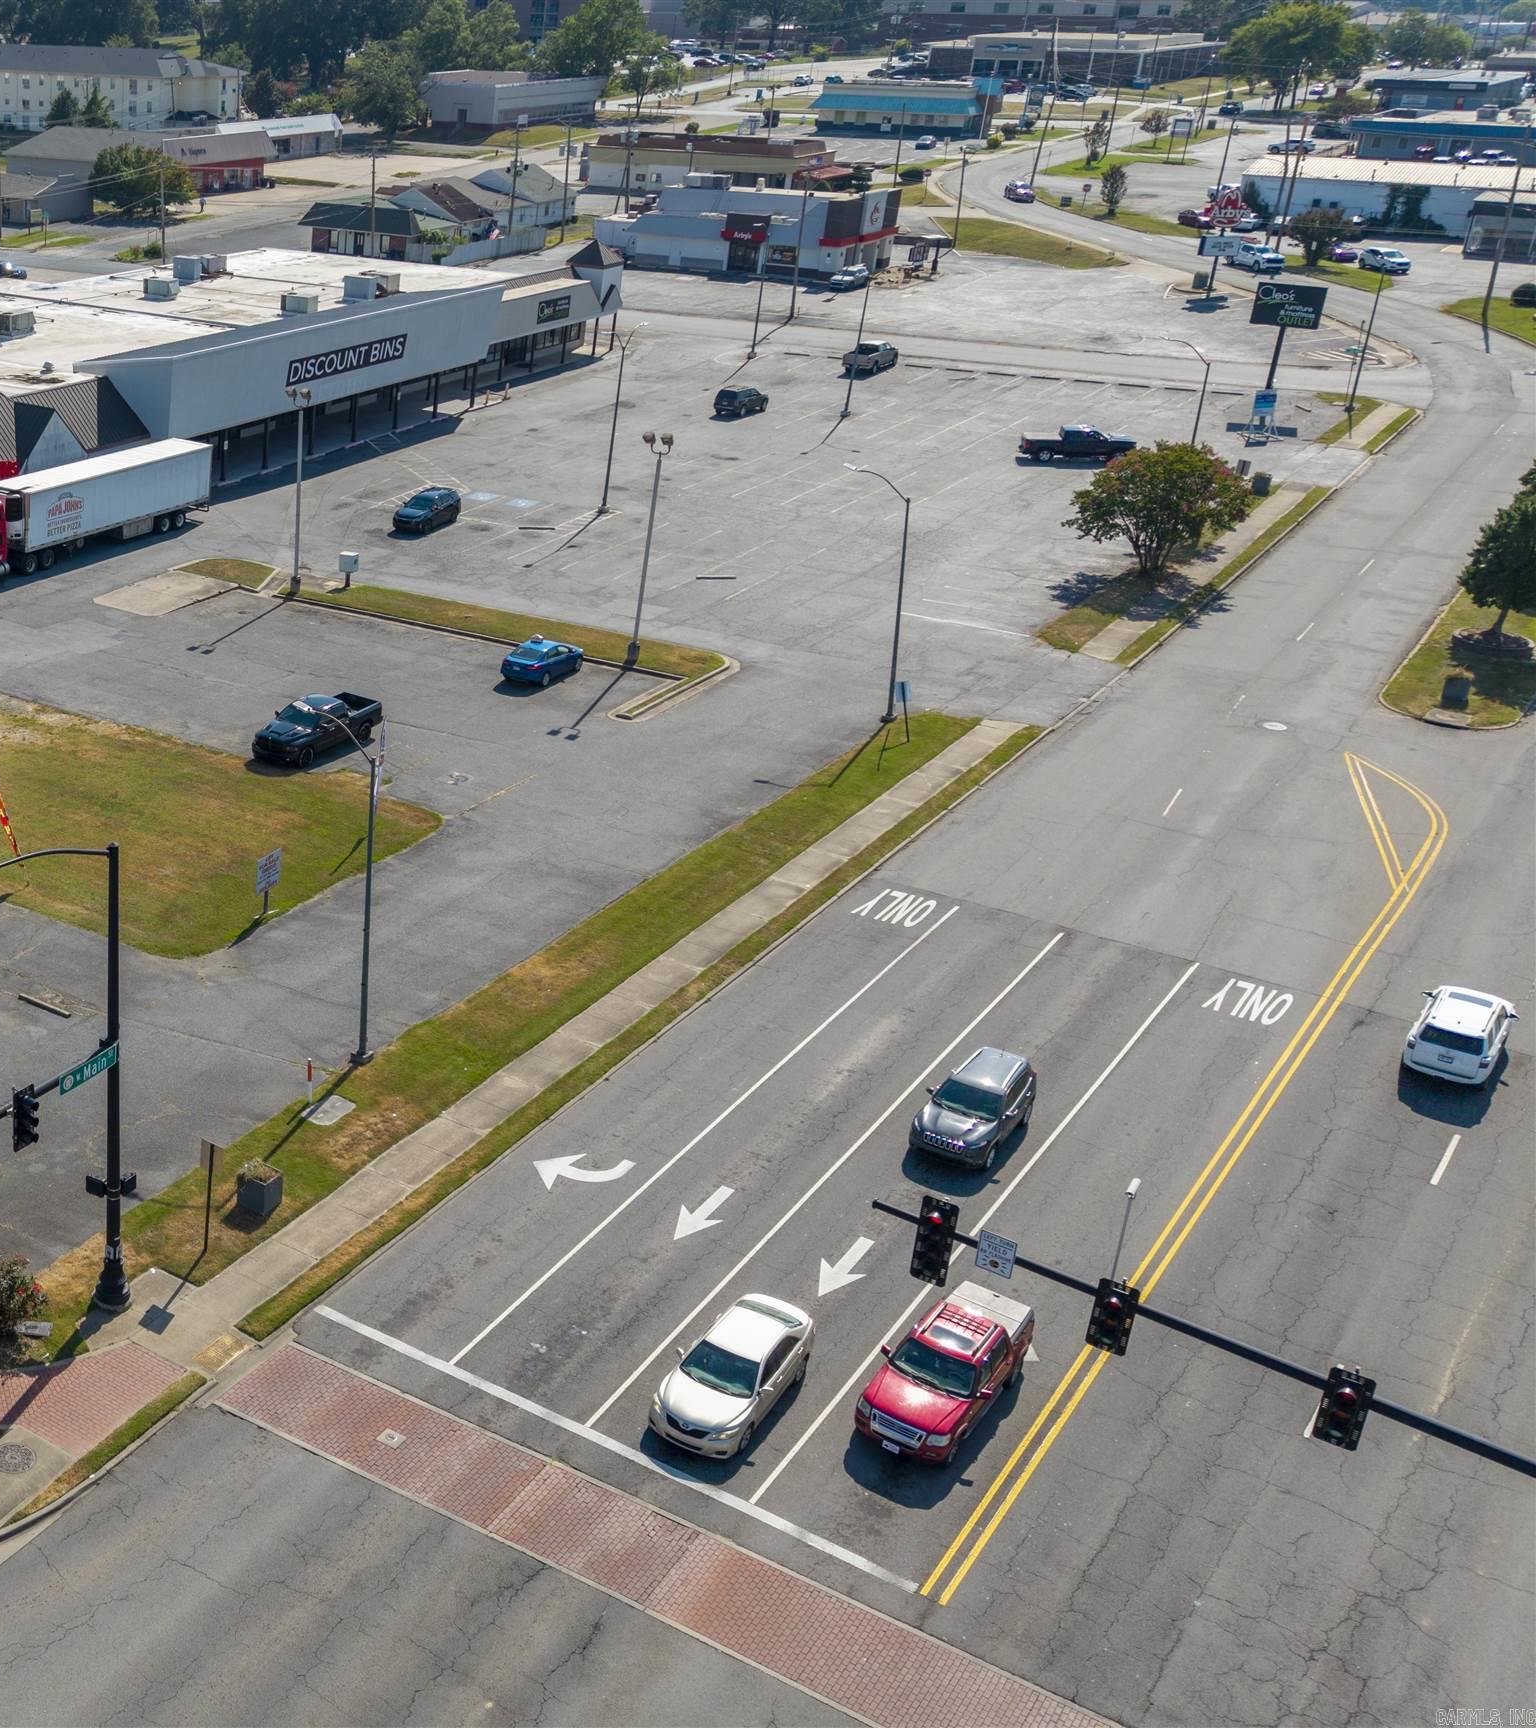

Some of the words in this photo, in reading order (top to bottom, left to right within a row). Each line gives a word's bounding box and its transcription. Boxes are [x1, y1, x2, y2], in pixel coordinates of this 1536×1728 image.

[1210, 203, 1251, 219] Arby's
[1258, 285, 1295, 300] Cleo's
[1277, 316, 1314, 326] OUTLET
[289, 346, 368, 382] DISCOUNT
[369, 337, 404, 363] BINS
[47, 502, 62, 519] PAPA
[47, 525, 65, 537] BETTER
[850, 888, 937, 928] ONLY
[1201, 977, 1294, 1025] ONLY
[83, 1056, 107, 1081] Main
[987, 1243, 1008, 1256] YIELD
